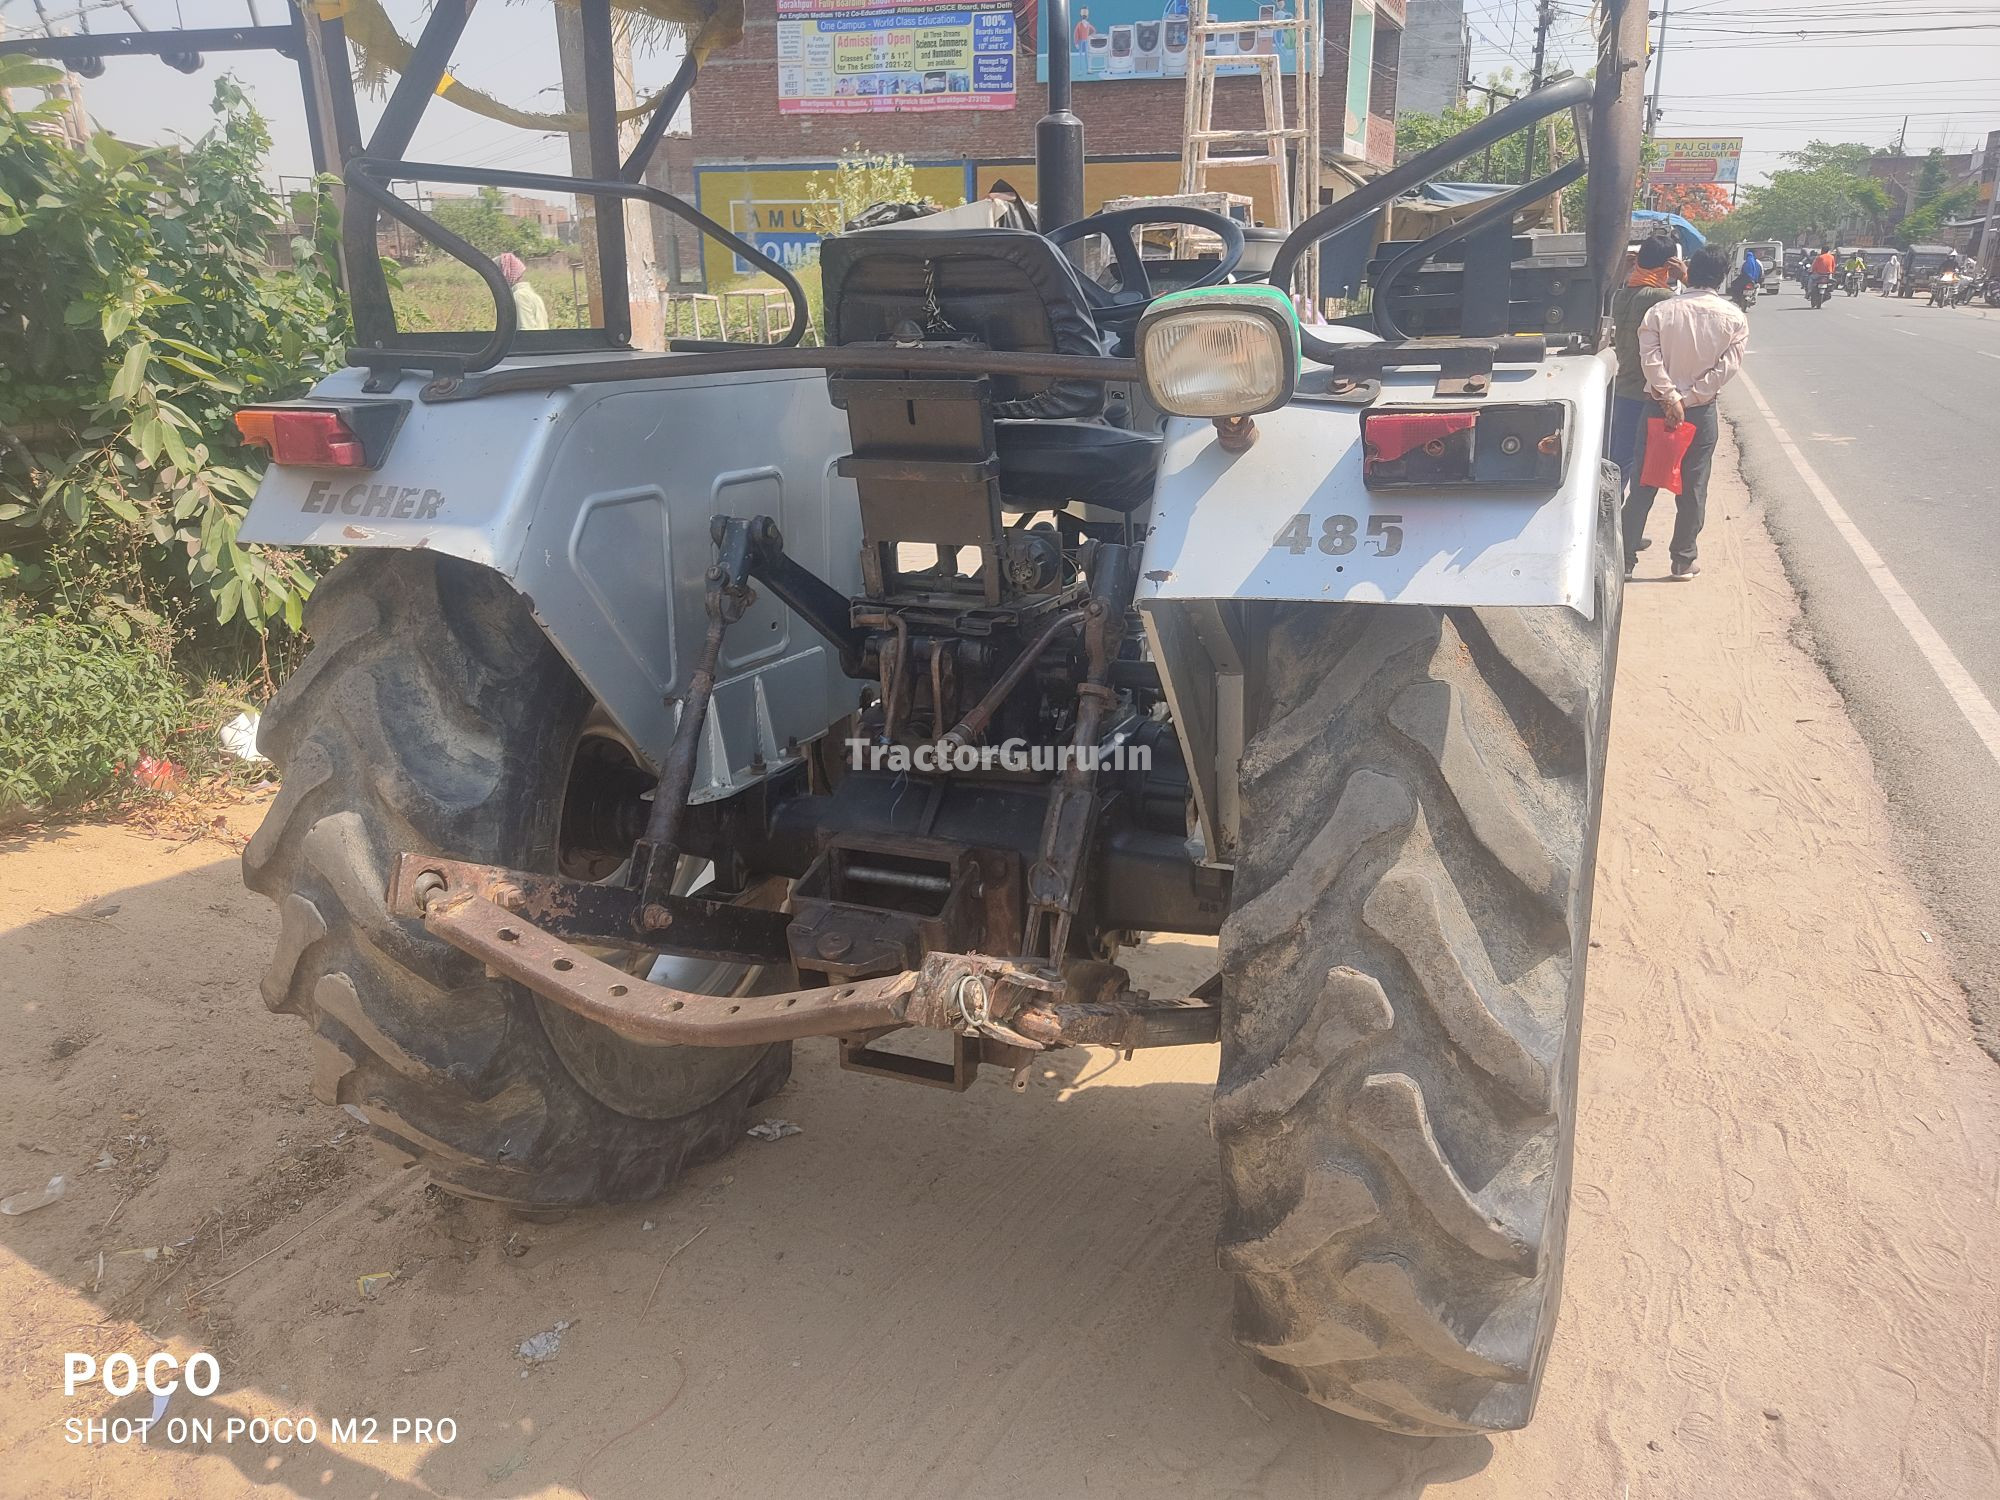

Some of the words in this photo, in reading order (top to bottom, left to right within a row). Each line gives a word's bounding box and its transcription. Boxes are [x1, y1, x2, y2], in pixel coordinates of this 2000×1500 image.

[850, 8, 896, 17] Co-Educational
[896, 6, 925, 14] Affiliated
[934, 4, 956, 12] CISCE
[820, 21, 835, 30] One
[836, 21, 866, 31] Campus
[873, 18, 894, 28] World
[895, 16, 917, 26] Class
[981, 15, 1007, 27] 100%
[837, 34, 884, 48] Admission
[887, 33, 911, 47] Open
[939, 39, 968, 47] Commerce
[840, 54, 864, 62] Classes
[921, 51, 931, 59] and
[931, 49, 962, 58] Humanities
[860, 62, 883, 70] Session
[885, 61, 912, 69] 2021-22
[1674, 142, 1694, 150] RAJ
[1697, 142, 1741, 150] GLOBAL
[1272, 513, 1404, 557] 485
